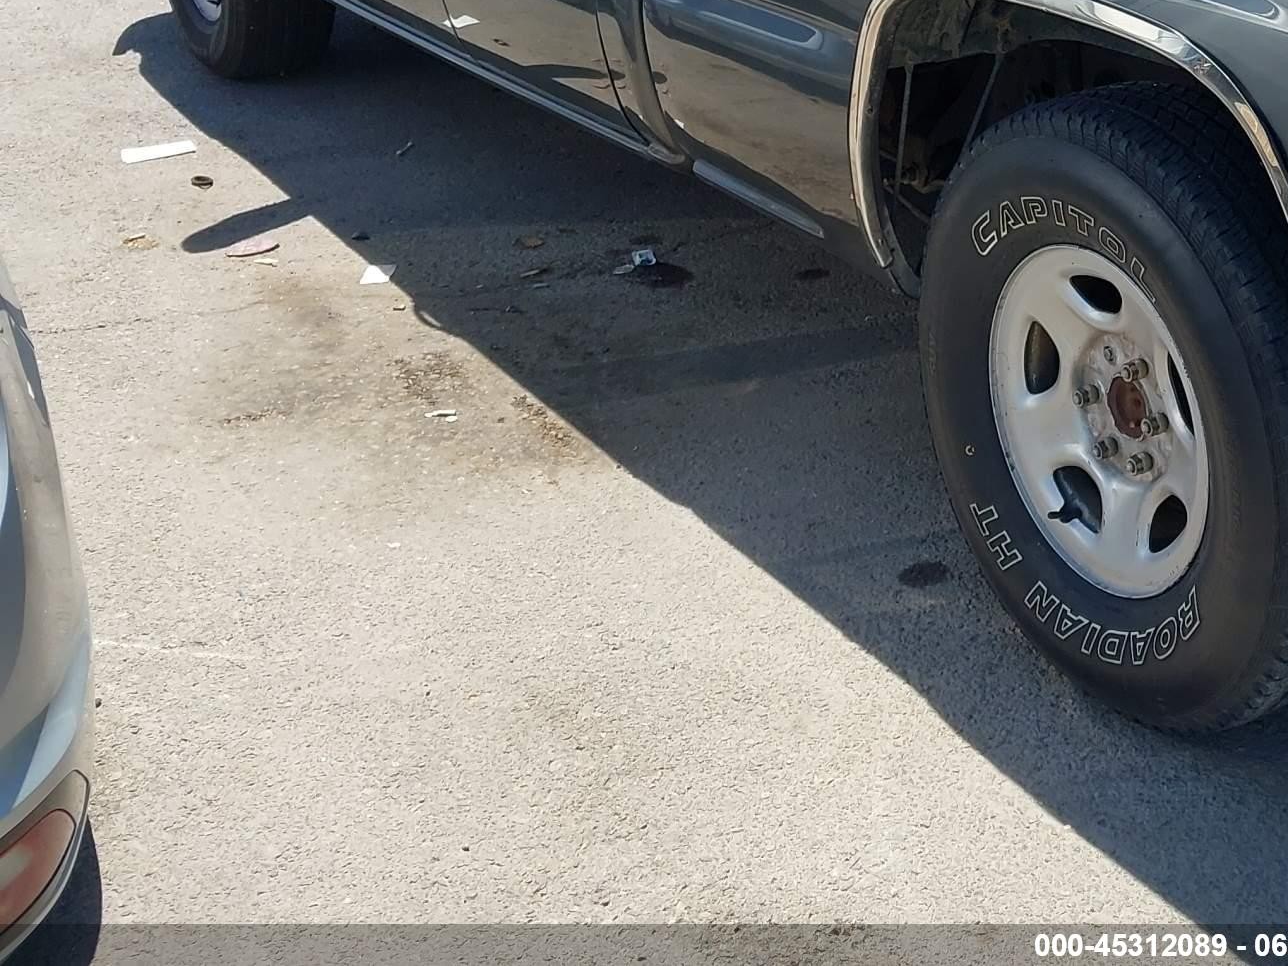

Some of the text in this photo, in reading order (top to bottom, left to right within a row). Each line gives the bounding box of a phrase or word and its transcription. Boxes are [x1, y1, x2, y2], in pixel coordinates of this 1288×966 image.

[970, 195, 1158, 304] CAPITOL
[968, 501, 1201, 667] ROADIAN HT
